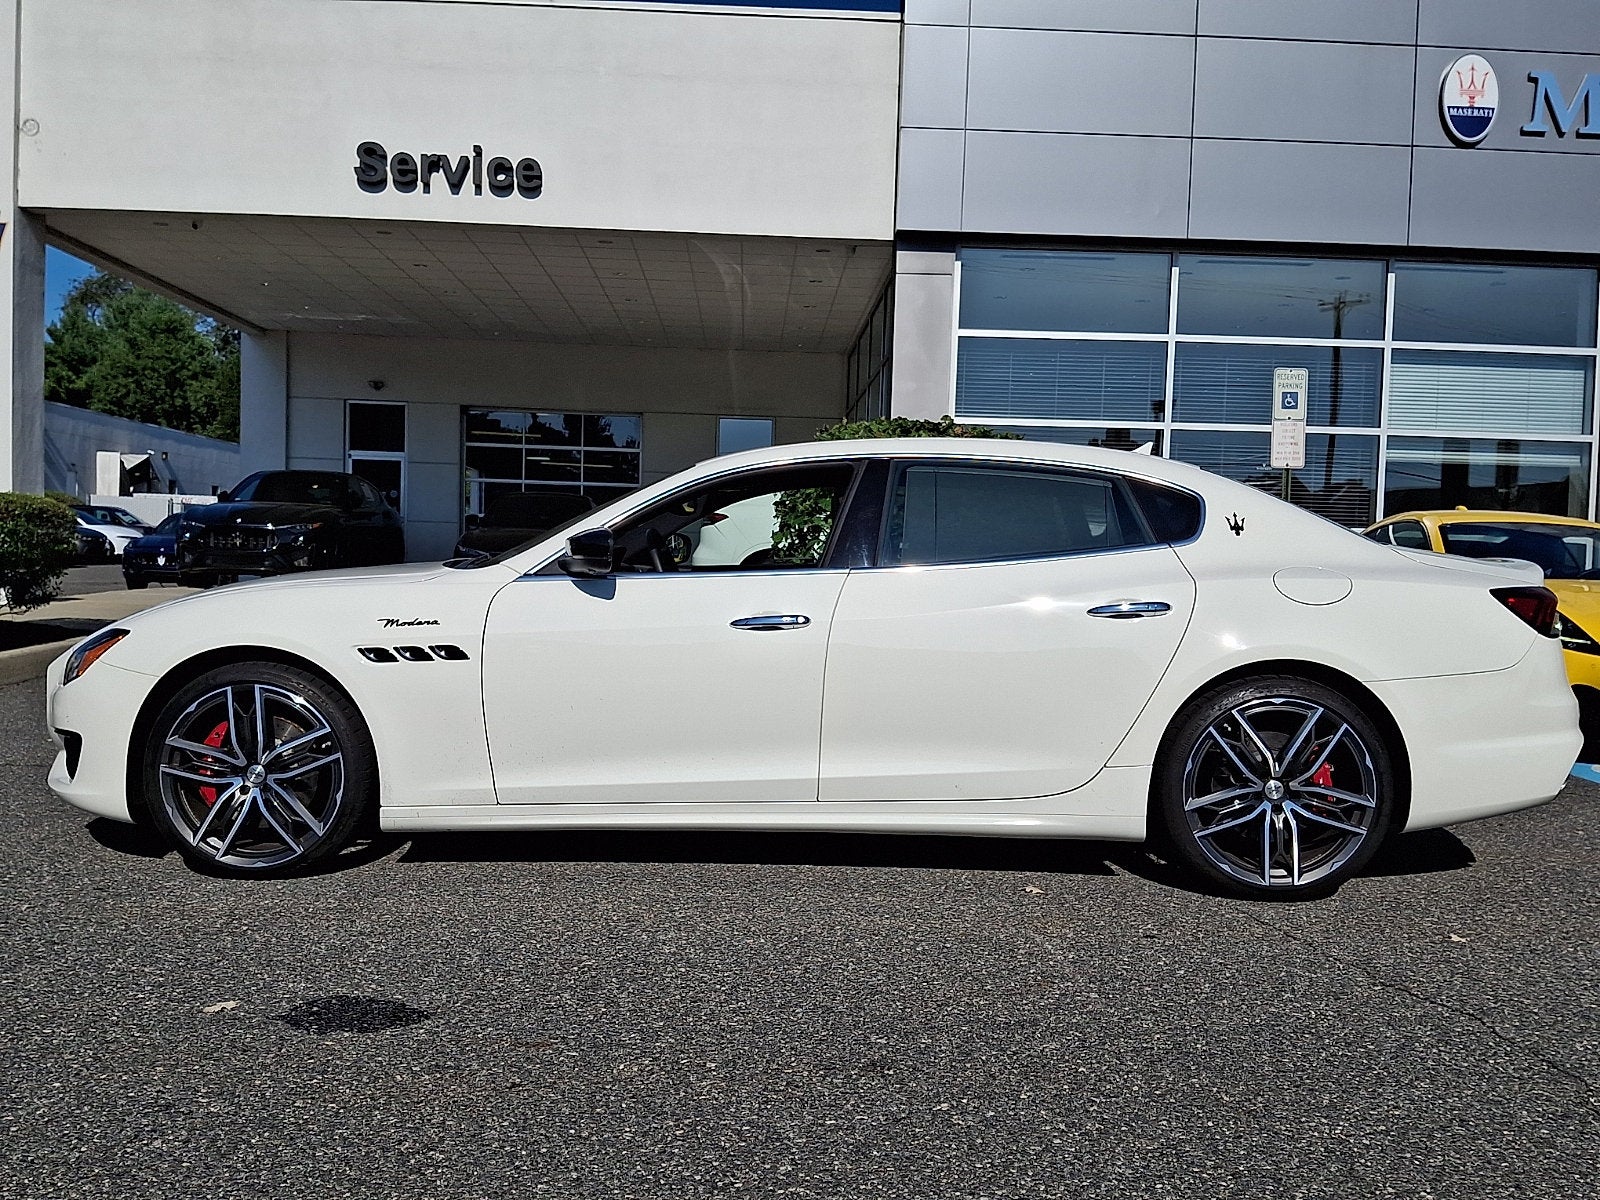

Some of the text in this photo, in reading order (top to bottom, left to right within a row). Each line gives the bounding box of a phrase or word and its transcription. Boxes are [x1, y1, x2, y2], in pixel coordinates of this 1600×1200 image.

[1449, 107, 1493, 118] MASERATI
[354, 141, 542, 199] Service
[1276, 373, 1305, 381] RESERVED
[1277, 382, 1304, 390] PARKING
[377, 617, 440, 629] Modena
